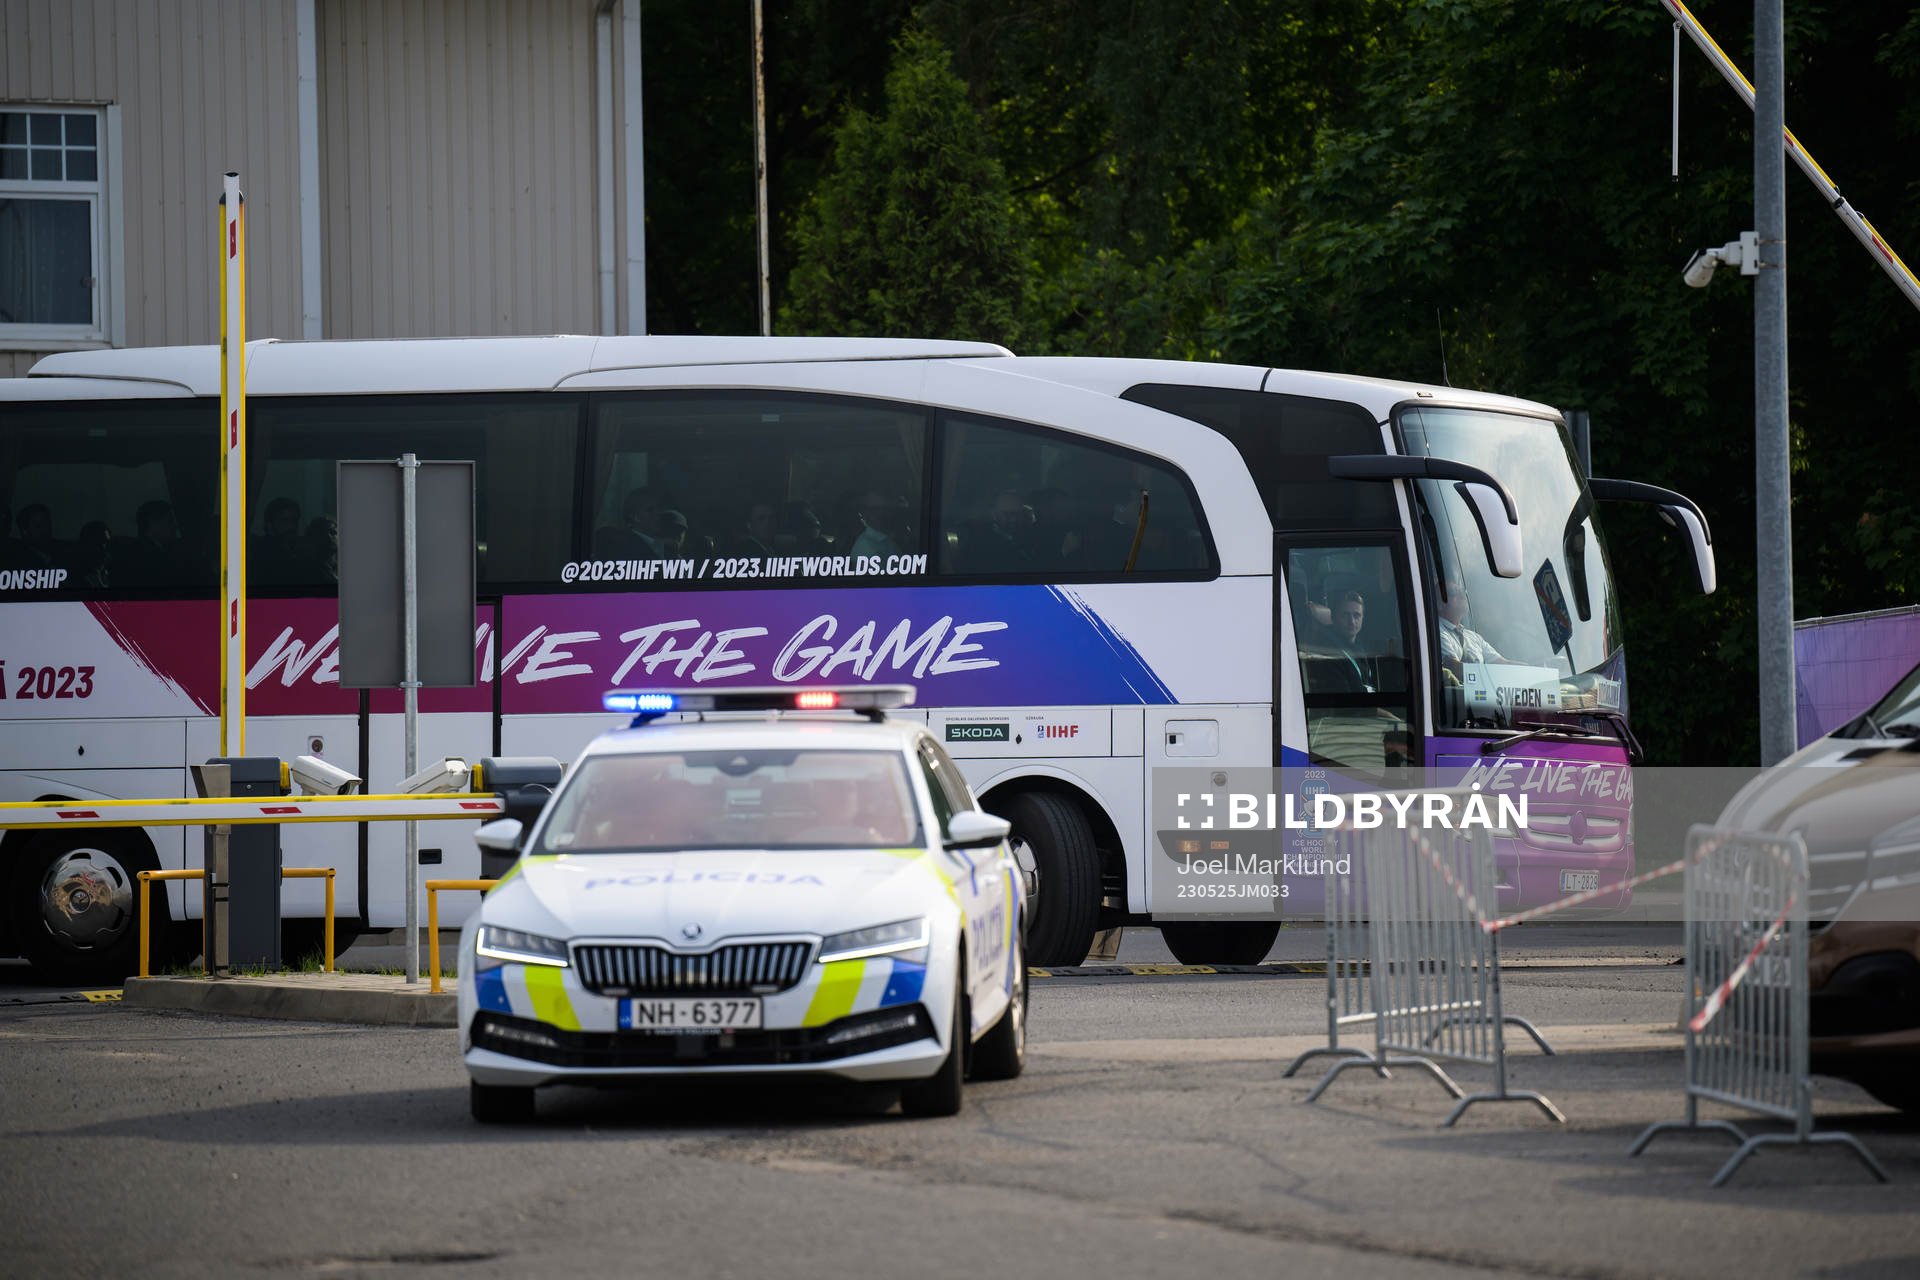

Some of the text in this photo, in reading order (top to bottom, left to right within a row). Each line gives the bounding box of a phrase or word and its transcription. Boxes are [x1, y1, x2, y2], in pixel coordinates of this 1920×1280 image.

[561, 558, 694, 583] @2023IIHFWM
[713, 553, 929, 579] 2023.IIHFWORLDS.COM
[611, 618, 769, 686] THE
[772, 614, 1009, 682] GAME
[15, 665, 96, 700] 2023
[1496, 686, 1542, 708] SWEDEN
[1046, 725, 1079, 738] IIHF
[1304, 770, 1326, 779] 2023
[1456, 752, 1524, 791] WE
[1520, 759, 1579, 794] LIVE
[1578, 763, 1615, 797] THE
[584, 870, 824, 890] POLICIJA
[1566, 874, 1598, 890] LT-2829
[638, 1003, 757, 1025] NH-6377
